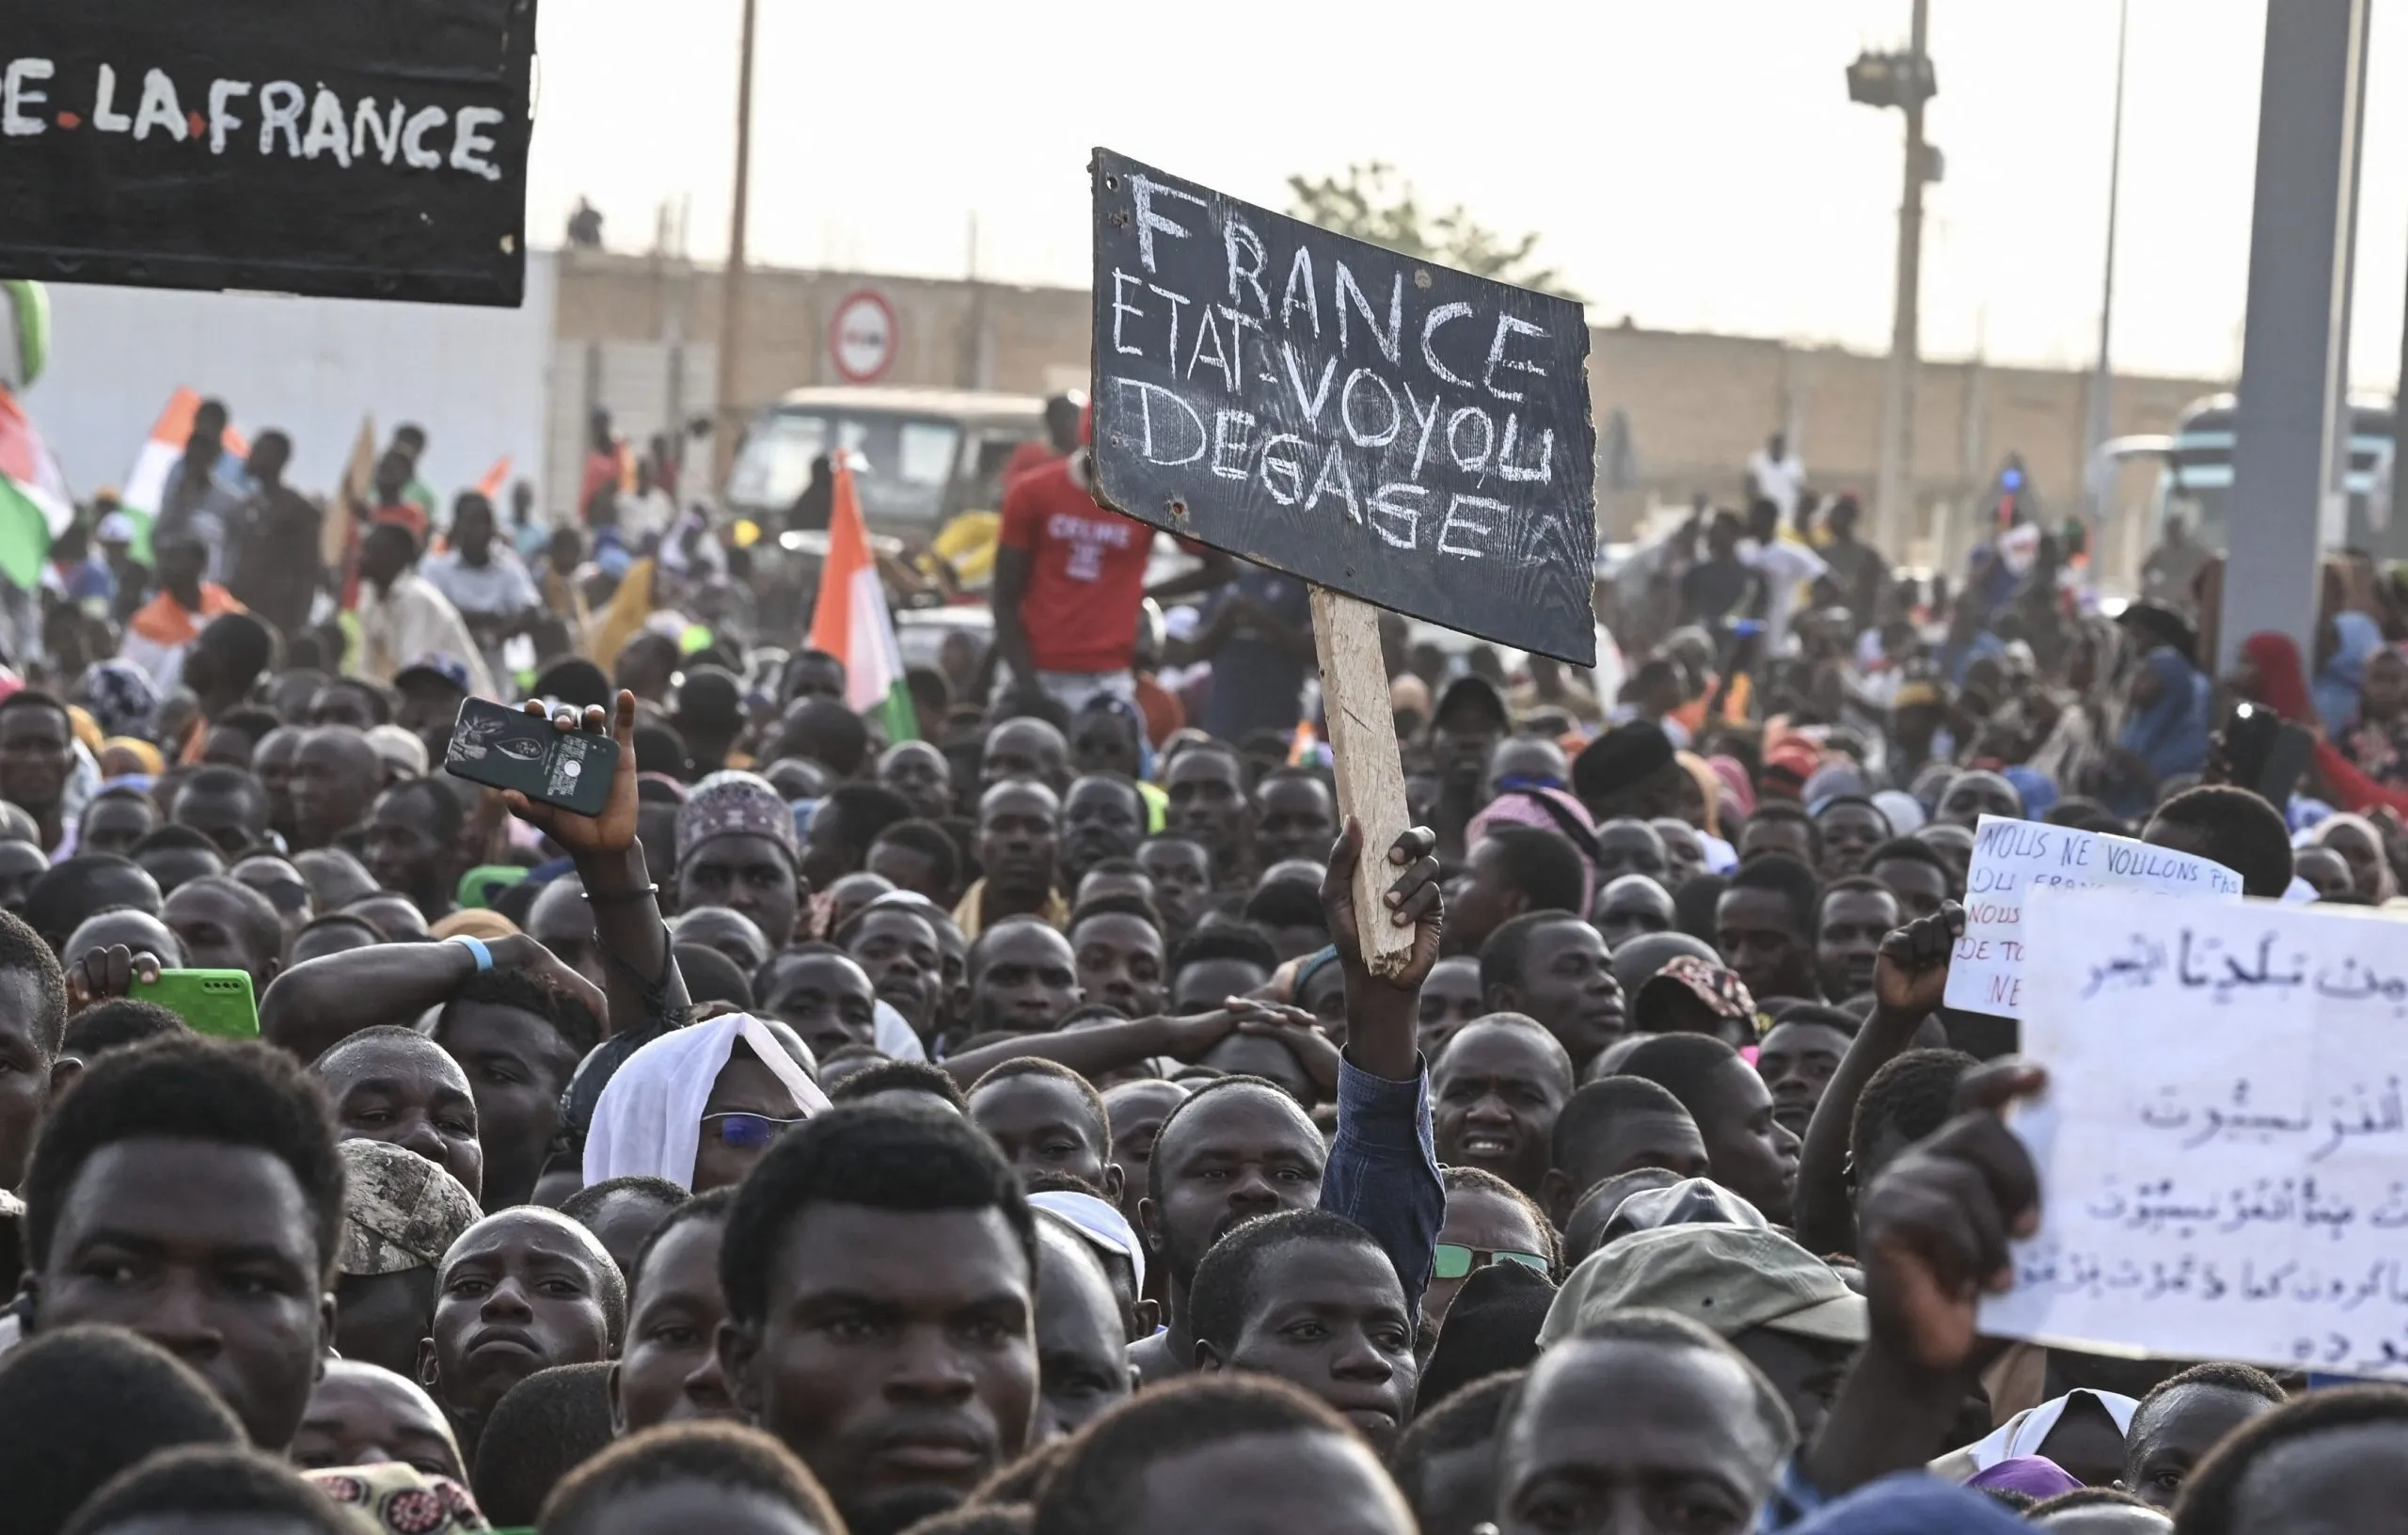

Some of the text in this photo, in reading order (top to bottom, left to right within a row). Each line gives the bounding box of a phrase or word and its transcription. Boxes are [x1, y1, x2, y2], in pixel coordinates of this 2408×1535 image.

[0, 58, 55, 135] E
[208, 79, 504, 181] FRANCE
[1124, 173, 1552, 403] FRANCE
[1106, 376, 1511, 559] DEGAGE
[1972, 865, 2014, 893] DU
[1979, 824, 2050, 860] NOUS
[2061, 834, 2091, 867] NE
[2101, 843, 2199, 882] VOULONS
[1968, 899, 2020, 925] NOUS
[1956, 937, 1990, 960] DE
